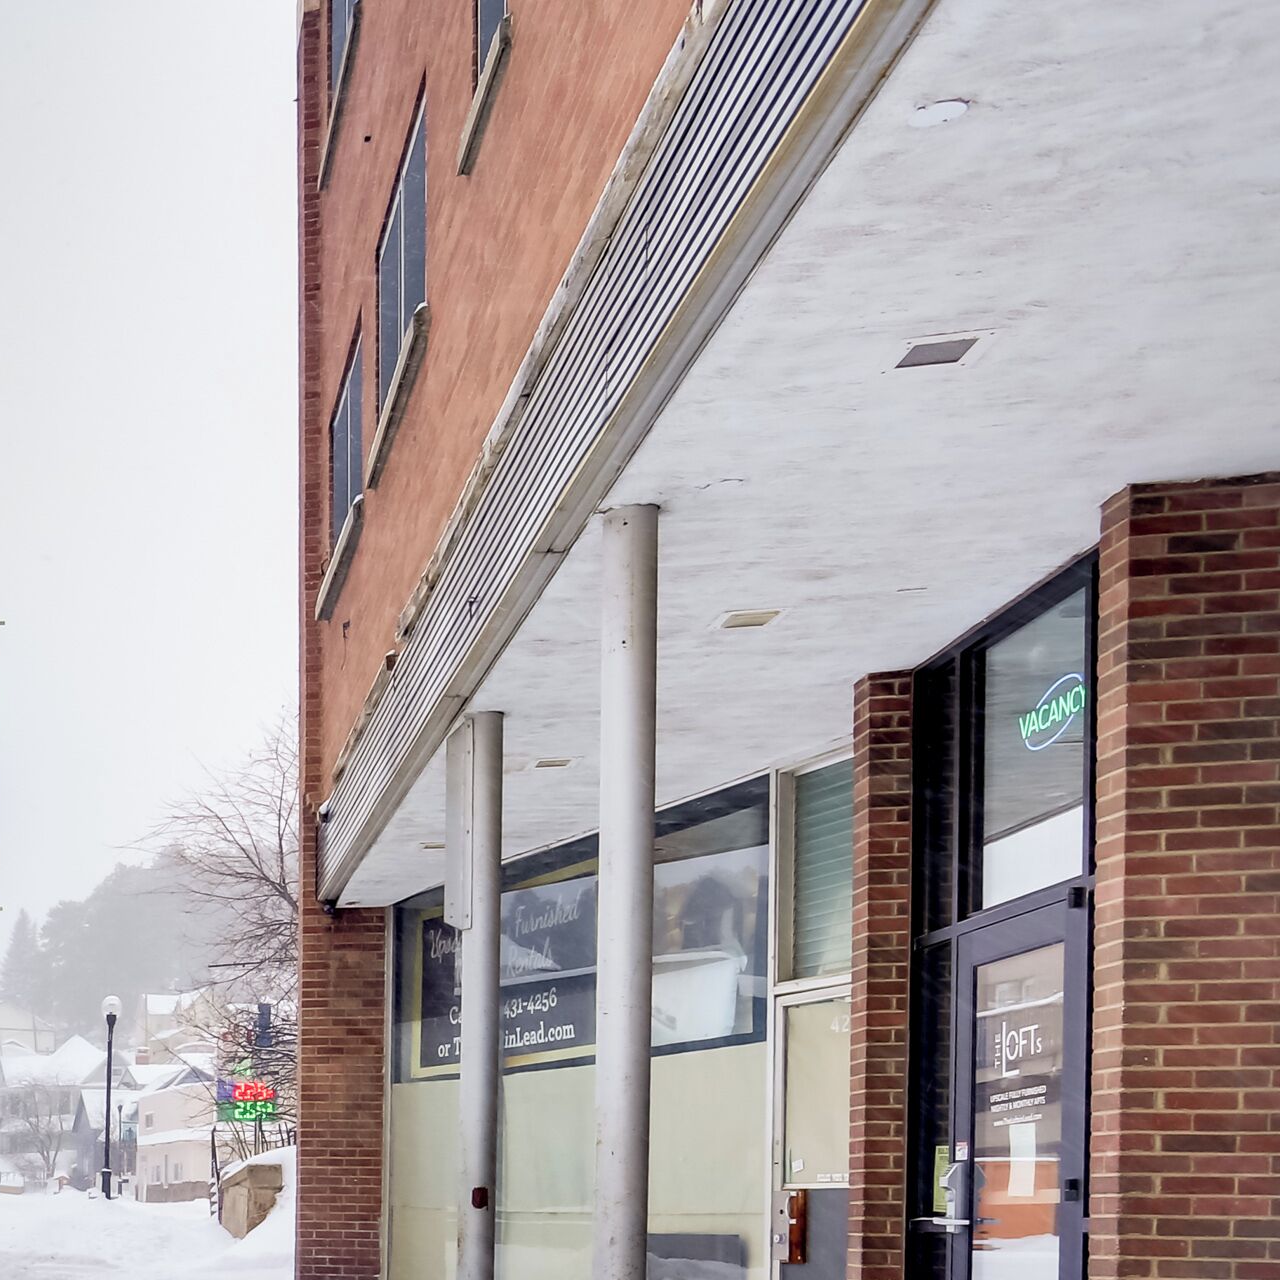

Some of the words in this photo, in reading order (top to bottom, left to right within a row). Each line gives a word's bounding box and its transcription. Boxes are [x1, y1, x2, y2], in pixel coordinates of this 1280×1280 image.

[1019, 685, 1086, 740] VACANCY
[515, 892, 580, 938] Furnished
[503, 987, 558, 1020] 431-4256
[437, 1043, 451, 1058] or
[503, 1021, 576, 1049] inLead.com
